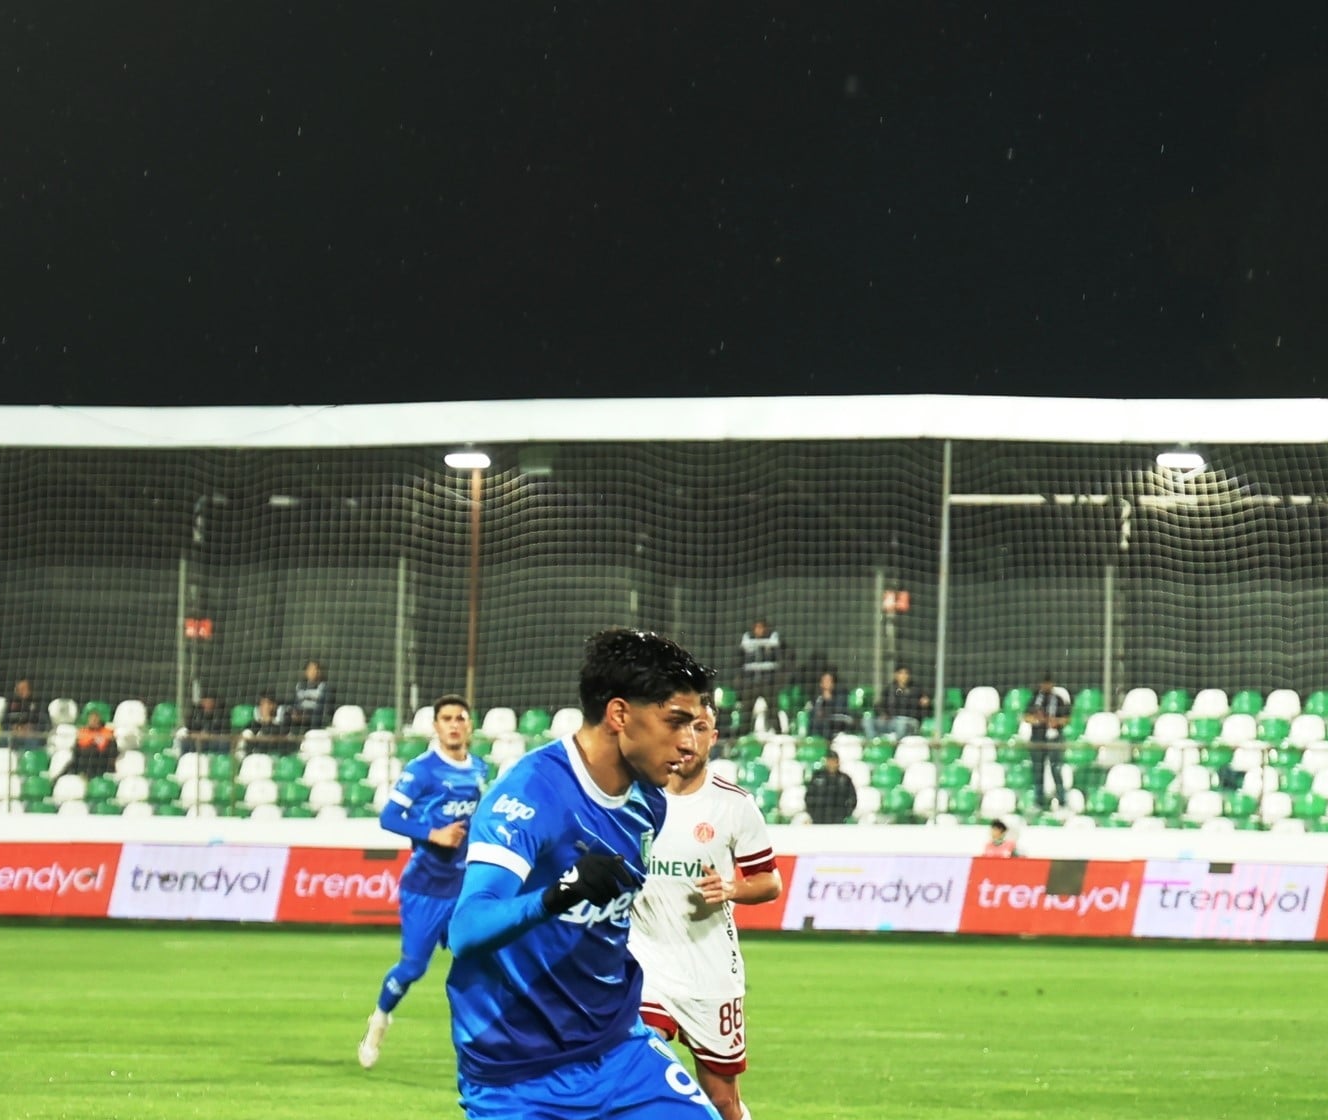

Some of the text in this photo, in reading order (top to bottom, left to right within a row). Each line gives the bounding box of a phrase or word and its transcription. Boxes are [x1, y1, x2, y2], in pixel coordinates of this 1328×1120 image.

[130, 863, 271, 897] trendyol
[294, 867, 400, 904] trendy
[807, 876, 954, 908] trendyol
[1159, 881, 1310, 918] trendyol
